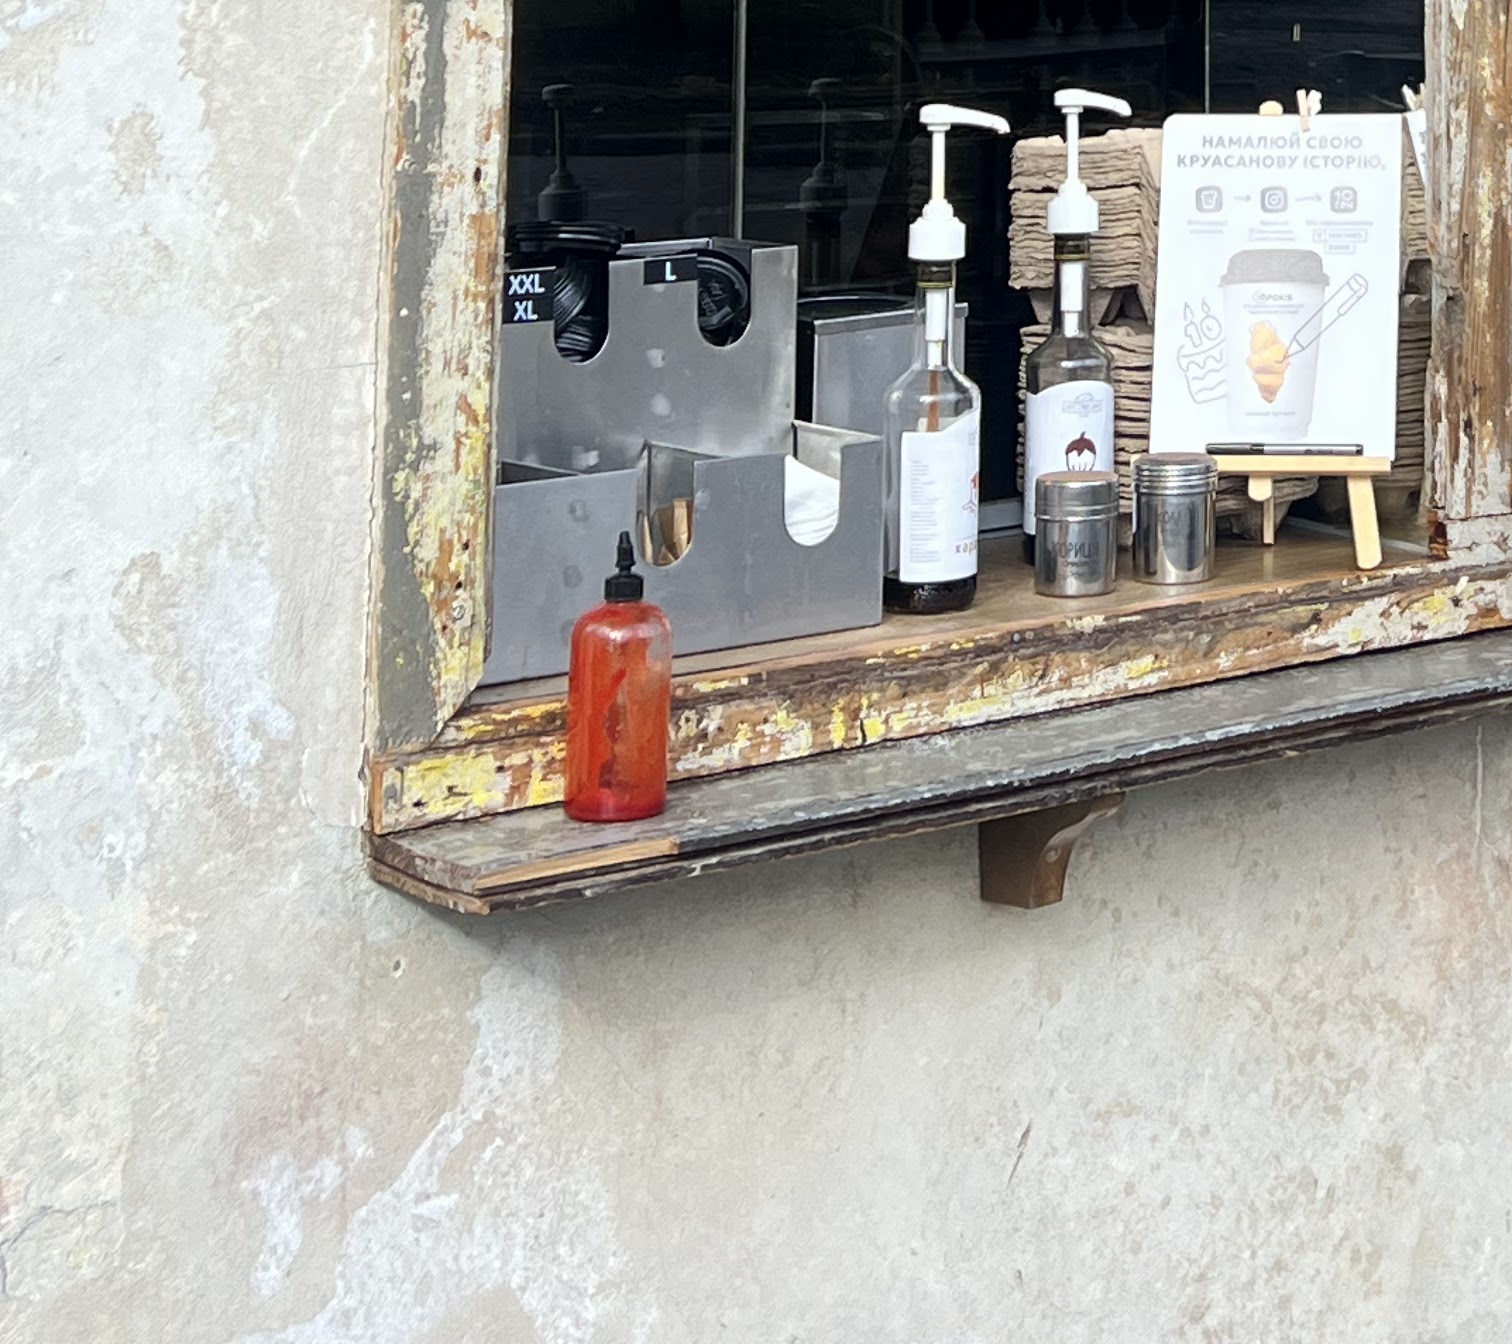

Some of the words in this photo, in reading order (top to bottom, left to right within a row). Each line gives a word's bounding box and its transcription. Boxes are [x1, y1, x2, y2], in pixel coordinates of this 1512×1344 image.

[1202, 132, 1301, 150] НАМАЛЮЙ
[1306, 135, 1363, 150] СВОЮ
[1177, 154, 1299, 170] КРУАСАНОВУ
[665, 261, 678, 282] L
[508, 274, 546, 296] XXL
[513, 301, 539, 321] XL
